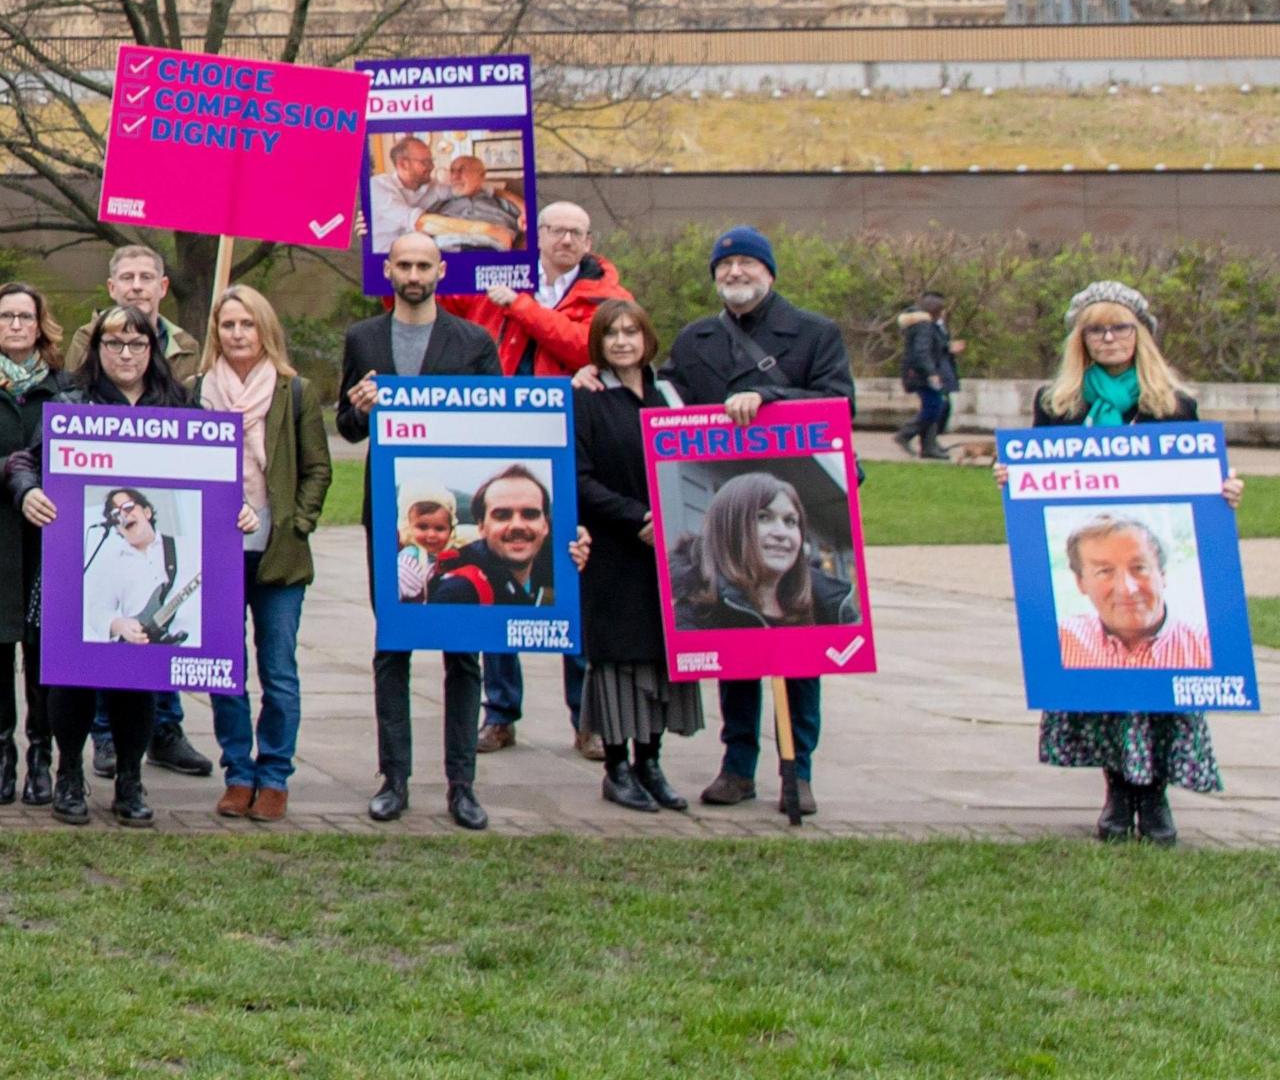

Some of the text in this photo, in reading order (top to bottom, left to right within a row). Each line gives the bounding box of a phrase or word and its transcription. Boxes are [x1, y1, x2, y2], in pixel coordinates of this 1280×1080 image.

[158, 57, 275, 94] CHOICE
[480, 63, 524, 83] FOR
[154, 87, 359, 134] COMPASSION
[369, 94, 434, 113] David
[151, 116, 280, 154] DIGNITY
[476, 270, 530, 280] DIGNITY
[377, 387, 564, 407] CAMPAIGN FOR
[50, 414, 236, 441] CAMPAIGN FOR
[386, 418, 427, 438] Ian
[650, 414, 708, 427] CAMPAIGN
[654, 421, 843, 457] CHRISTIE.
[1005, 433, 1217, 460] CAMPAIGN FOR
[58, 447, 113, 468] Tom
[1019, 470, 1119, 492] Adrian
[507, 626, 569, 637] DIGNITY
[508, 636, 574, 648] IN DYING.
[171, 663, 231, 676] DIGNITY
[171, 674, 236, 688] IN DYING.
[1174, 682, 1245, 694] DIGNITY
[1175, 694, 1251, 706] IN DYING.
